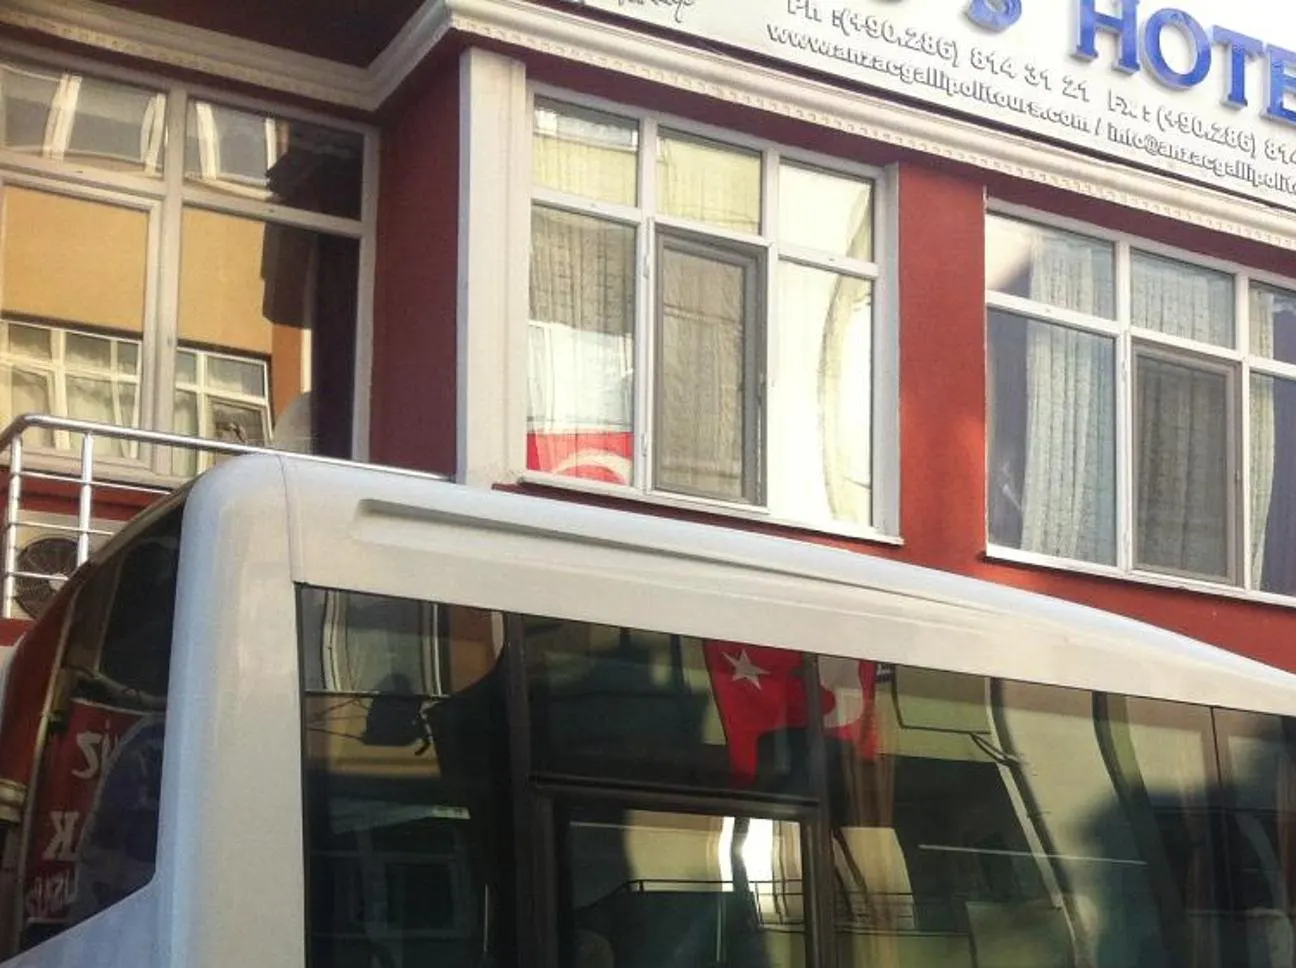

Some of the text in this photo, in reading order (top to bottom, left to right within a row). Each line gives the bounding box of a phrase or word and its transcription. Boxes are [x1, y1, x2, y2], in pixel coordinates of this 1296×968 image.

[766, 22, 1092, 134] www.anzacgallipolitours.com
[970, 46, 1017, 80] 814
[1024, 62, 1052, 91] 31
[1062, 74, 1091, 103] 21
[1156, 105, 1257, 159] (+90.286)
